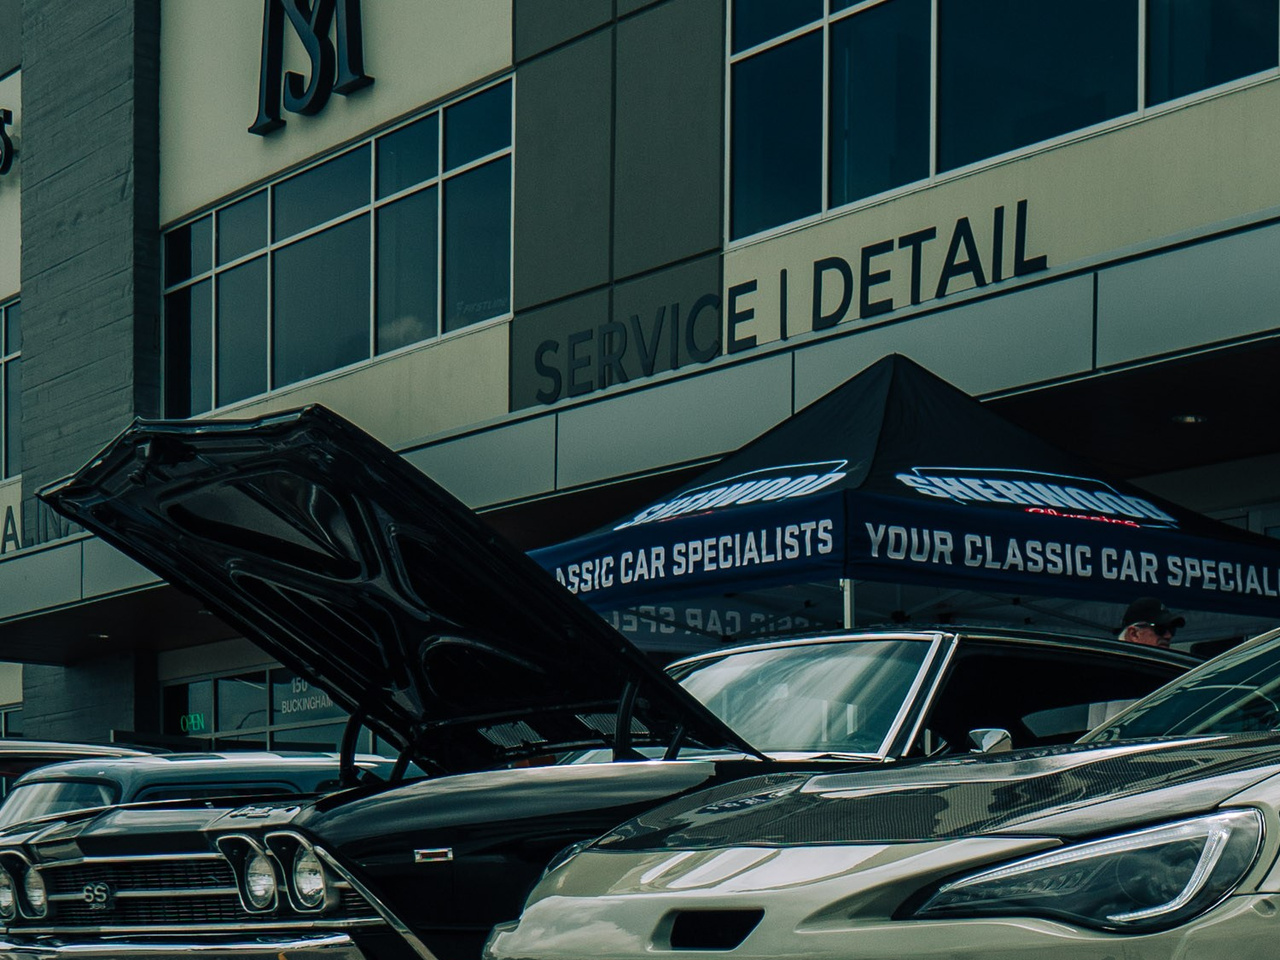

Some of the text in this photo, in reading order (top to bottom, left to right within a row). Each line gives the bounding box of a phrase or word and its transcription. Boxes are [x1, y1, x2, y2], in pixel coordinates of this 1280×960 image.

[535, 279, 757, 405] SERVICE
[813, 199, 1048, 333] DETAIL
[613, 472, 847, 531] SHERWOOD
[895, 473, 1178, 523] SHERWOOD
[620, 546, 665, 584] CAR
[672, 518, 834, 576] SPECIALISTS
[865, 522, 953, 565] YOUR
[964, 533, 1092, 577] CLASSIC
[1102, 547, 1159, 584] CAR
[281, 695, 334, 714] BUCKINGHAM
[291, 677, 308, 693] 150
[181, 713, 205, 732] OPEN
[83, 885, 107, 903] SS
